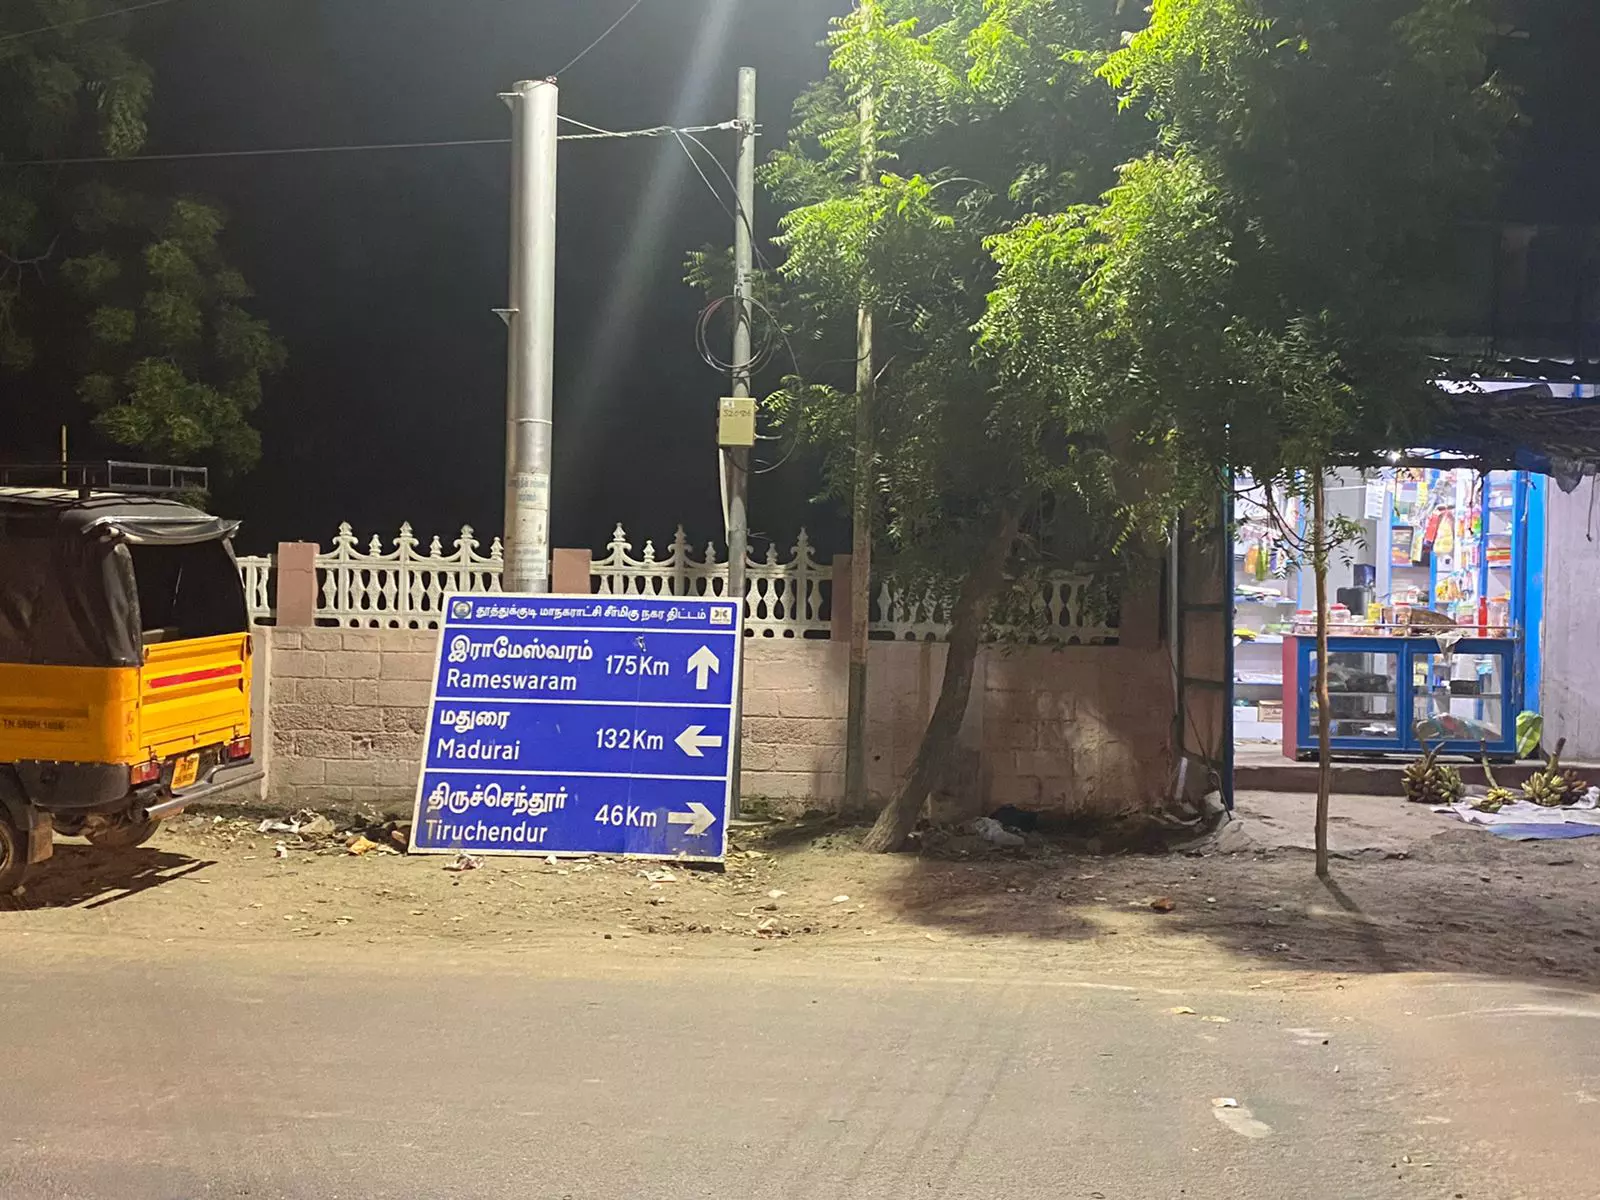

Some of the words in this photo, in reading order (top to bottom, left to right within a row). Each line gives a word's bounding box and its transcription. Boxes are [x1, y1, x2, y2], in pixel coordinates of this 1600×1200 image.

[475, 603, 537, 620] தூத்துக்குடி
[540, 605, 602, 620] மாநகராட்சி
[641, 609, 665, 622] நகர
[666, 607, 707, 622] திட்டம்
[447, 634, 593, 663] இராமேஸ்வரம்
[446, 668, 577, 691] Rameswaram
[440, 709, 511, 733] மதுரை
[436, 738, 520, 760] Madurai
[426, 782, 568, 816] திருச்செந்தூர்
[425, 819, 548, 842] Tiruchendur
